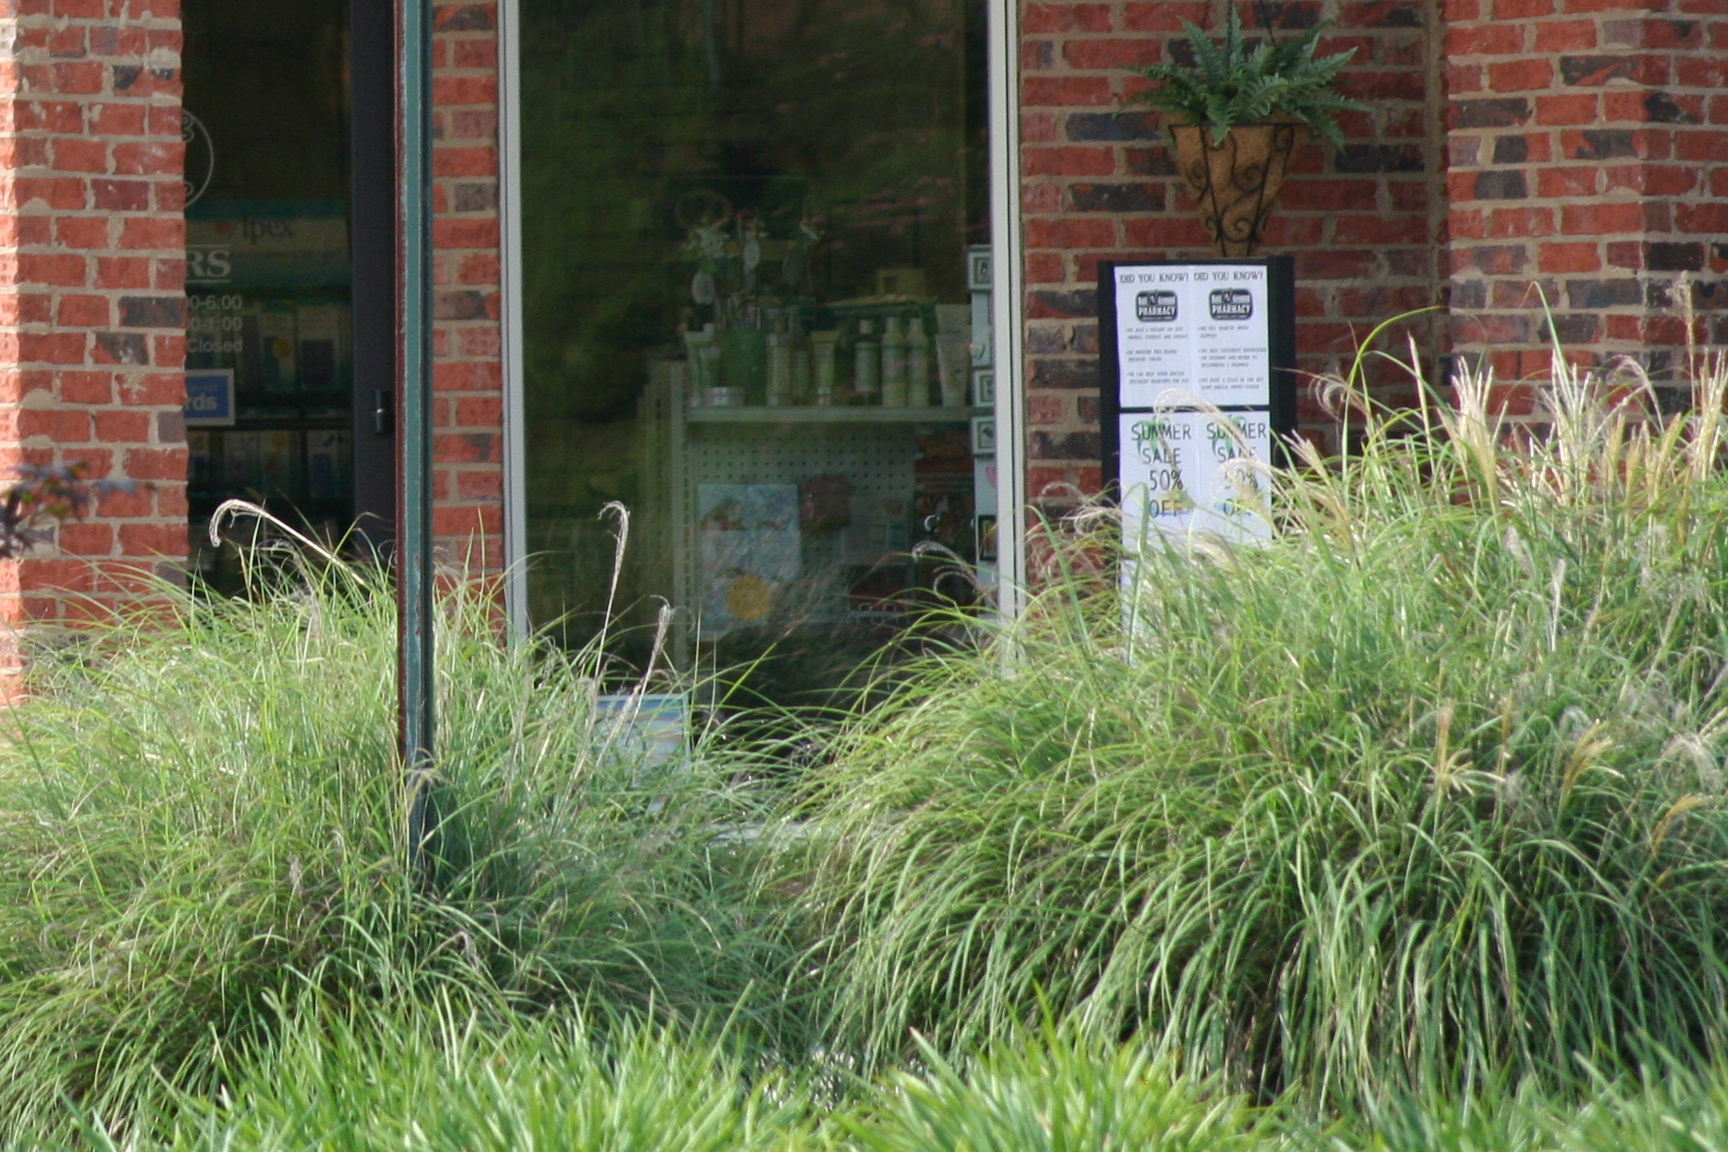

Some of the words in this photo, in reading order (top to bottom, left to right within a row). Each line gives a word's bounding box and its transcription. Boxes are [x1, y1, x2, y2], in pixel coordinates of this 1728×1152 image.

[187, 337, 243, 353] Closed
[1131, 422, 1192, 441] SUMMER
[1142, 447, 1182, 464] SALE
[1149, 468, 1183, 491] 50%
